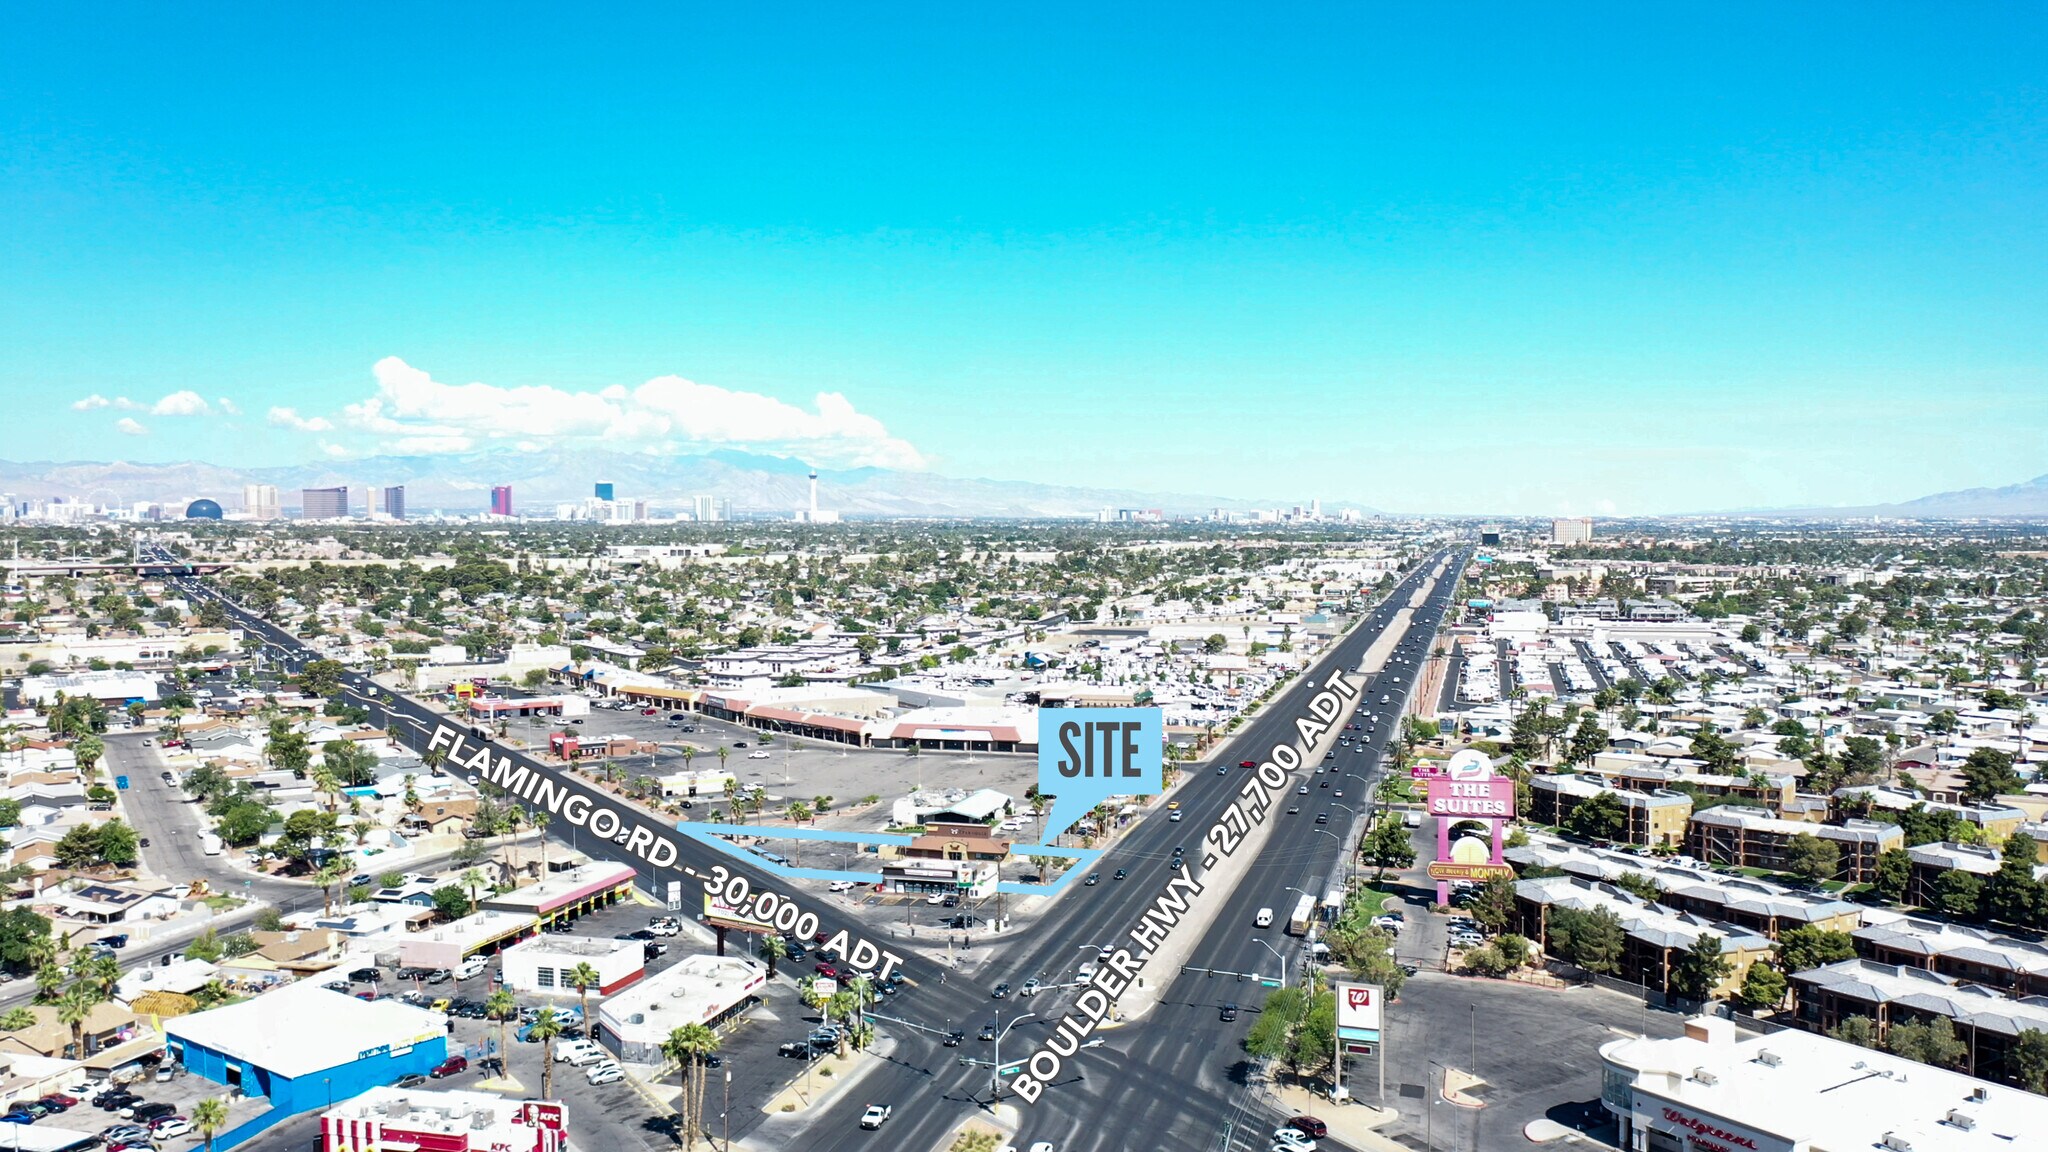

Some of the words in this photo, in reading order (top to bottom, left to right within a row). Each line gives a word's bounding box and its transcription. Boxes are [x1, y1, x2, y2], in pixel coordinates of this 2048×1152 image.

[1450, 782, 1490, 797] THE
[1433, 799, 1506, 814] SUITES
[540, 1112, 559, 1122] KFC
[1662, 1107, 1758, 1150] Walgreens
[490, 1142, 512, 1152] KFC
